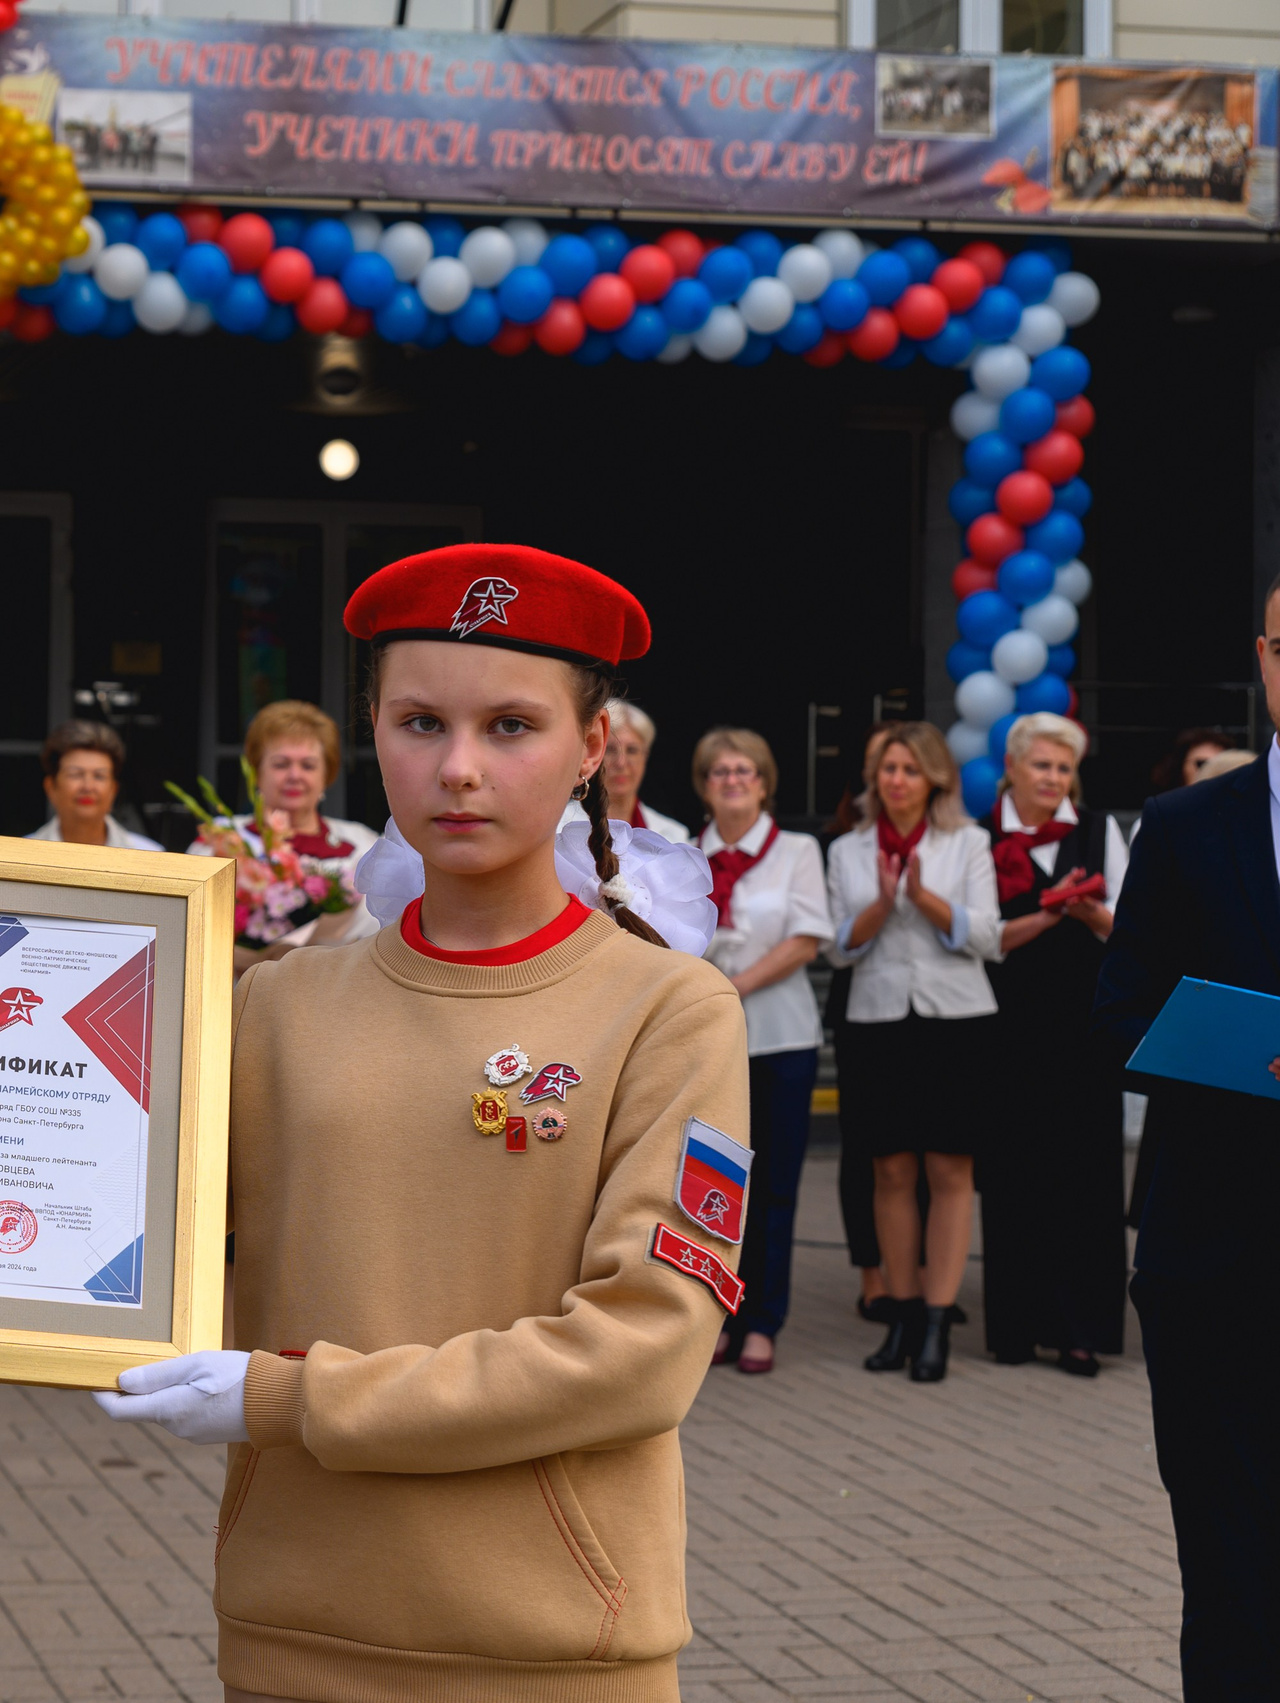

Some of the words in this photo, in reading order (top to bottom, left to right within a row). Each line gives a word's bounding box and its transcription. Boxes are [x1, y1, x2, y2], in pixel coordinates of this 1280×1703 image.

[22, 946, 64, 955] ВСЕРОССИЙСКОЕ
[65, 950, 118, 959] ДЕТСКО-ЮНОШЕСКОЕ
[21, 954, 88, 964] ВОЕННО-ПАТРИОТИЧЕСКОЕ
[21, 961, 61, 969] ОБЩЕСТВЕННОЕ
[72, 1091, 111, 1104] ОТРЯДУ
[15, 1104, 37, 1114] ГБОУ
[38, 1106, 58, 1115] СОШ
[59, 1108, 82, 1117] №335
[13, 1116, 85, 1131] Санкт-Петербурга
[10, 1153, 51, 1164] младшего
[52, 1156, 97, 1167] лейтенанта
[44, 1202, 73, 1210] Начальник
[34, 1208, 55, 1216] ВВПОД
[56, 1210, 92, 1218] «ЮНАРМИЯ»
[42, 1215, 92, 1225] Санкт-Петербурга
[6, 1262, 22, 1270] 2024
